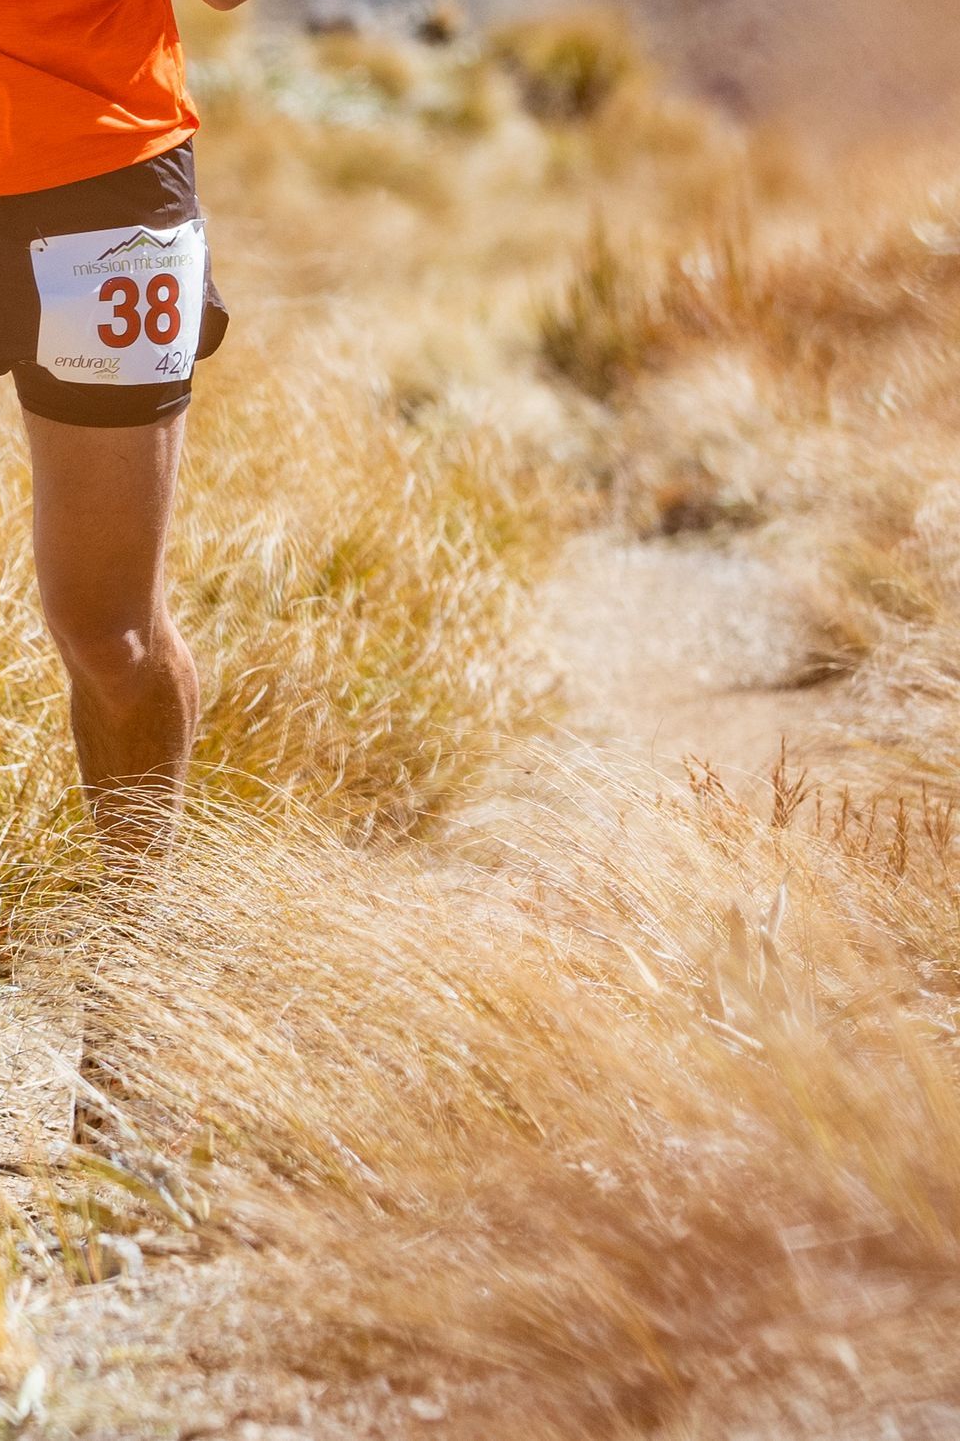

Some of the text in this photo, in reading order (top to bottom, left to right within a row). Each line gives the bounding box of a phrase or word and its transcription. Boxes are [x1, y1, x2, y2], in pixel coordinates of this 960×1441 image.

[73, 259, 131, 276] mission
[134, 256, 152, 270] mt
[97, 273, 181, 348] 38
[54, 355, 121, 369] enduranz
